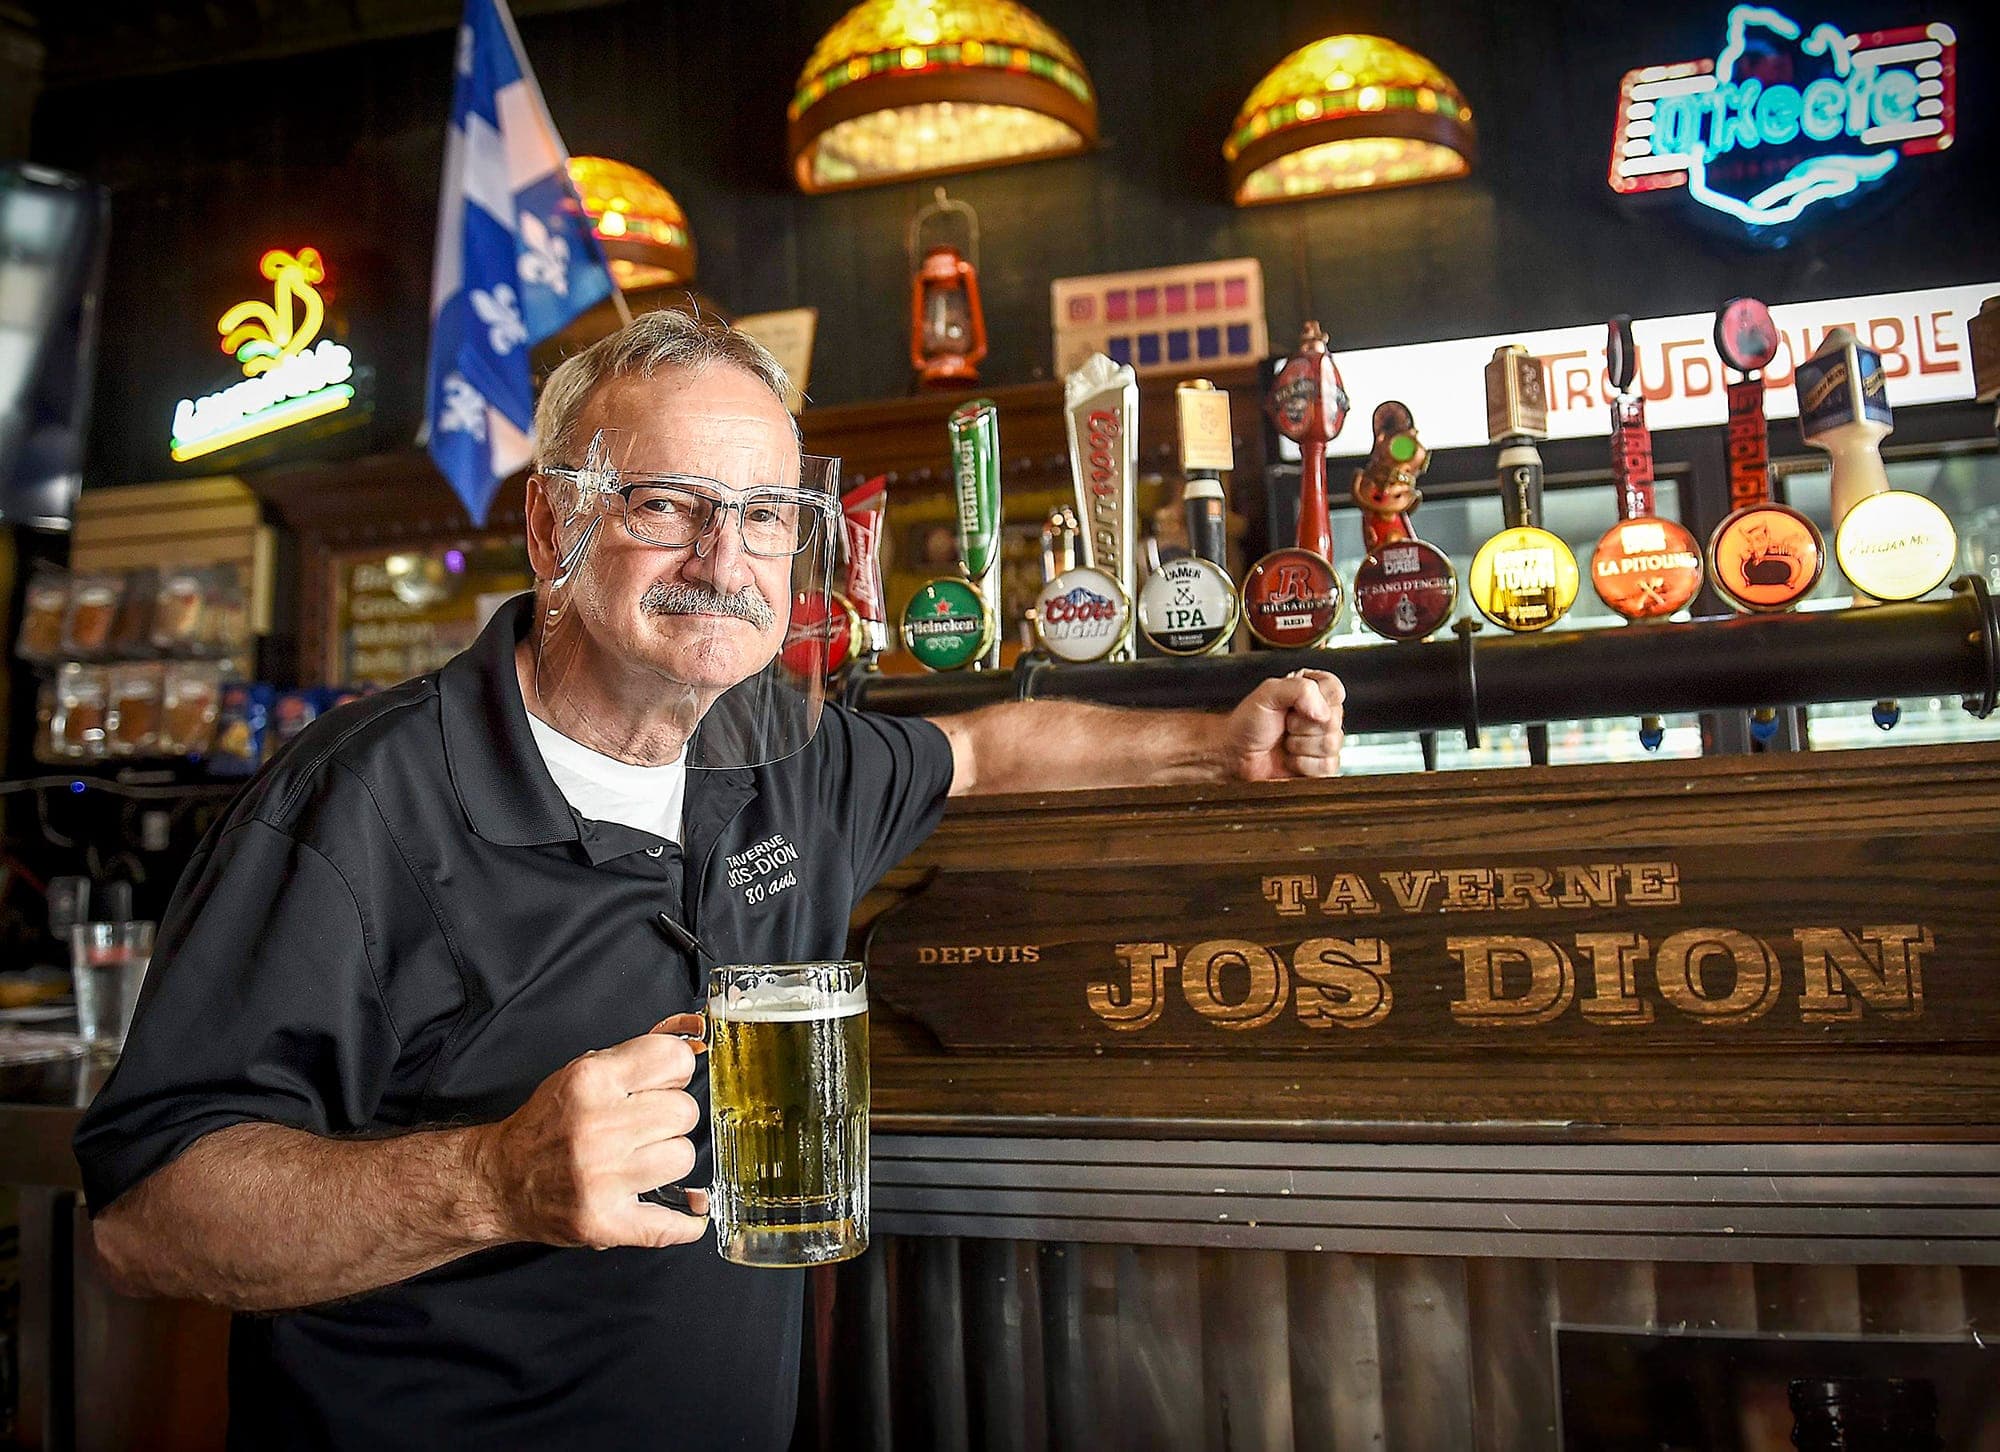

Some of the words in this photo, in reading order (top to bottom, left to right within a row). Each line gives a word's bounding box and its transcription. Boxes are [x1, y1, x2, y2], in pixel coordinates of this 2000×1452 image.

[1087, 407, 1121, 499] Coors
[960, 440, 979, 531] Heineken
[1597, 560, 1620, 576] LA
[1372, 582, 1401, 595] SANG
[1045, 596, 1116, 624] Coors
[1166, 609, 1206, 629] IPA
[1283, 618, 1304, 626] RED
[911, 618, 974, 636] Heineken
[725, 834, 785, 868] TAVERNE
[728, 843, 798, 887] JOS-DION
[745, 884, 764, 904] 80
[768, 870, 797, 894] ans
[1262, 861, 1681, 916] TAVERNE
[918, 944, 1041, 965] DEPUIS
[1086, 937, 1394, 1030] JOS
[1446, 924, 1935, 1027] DION
